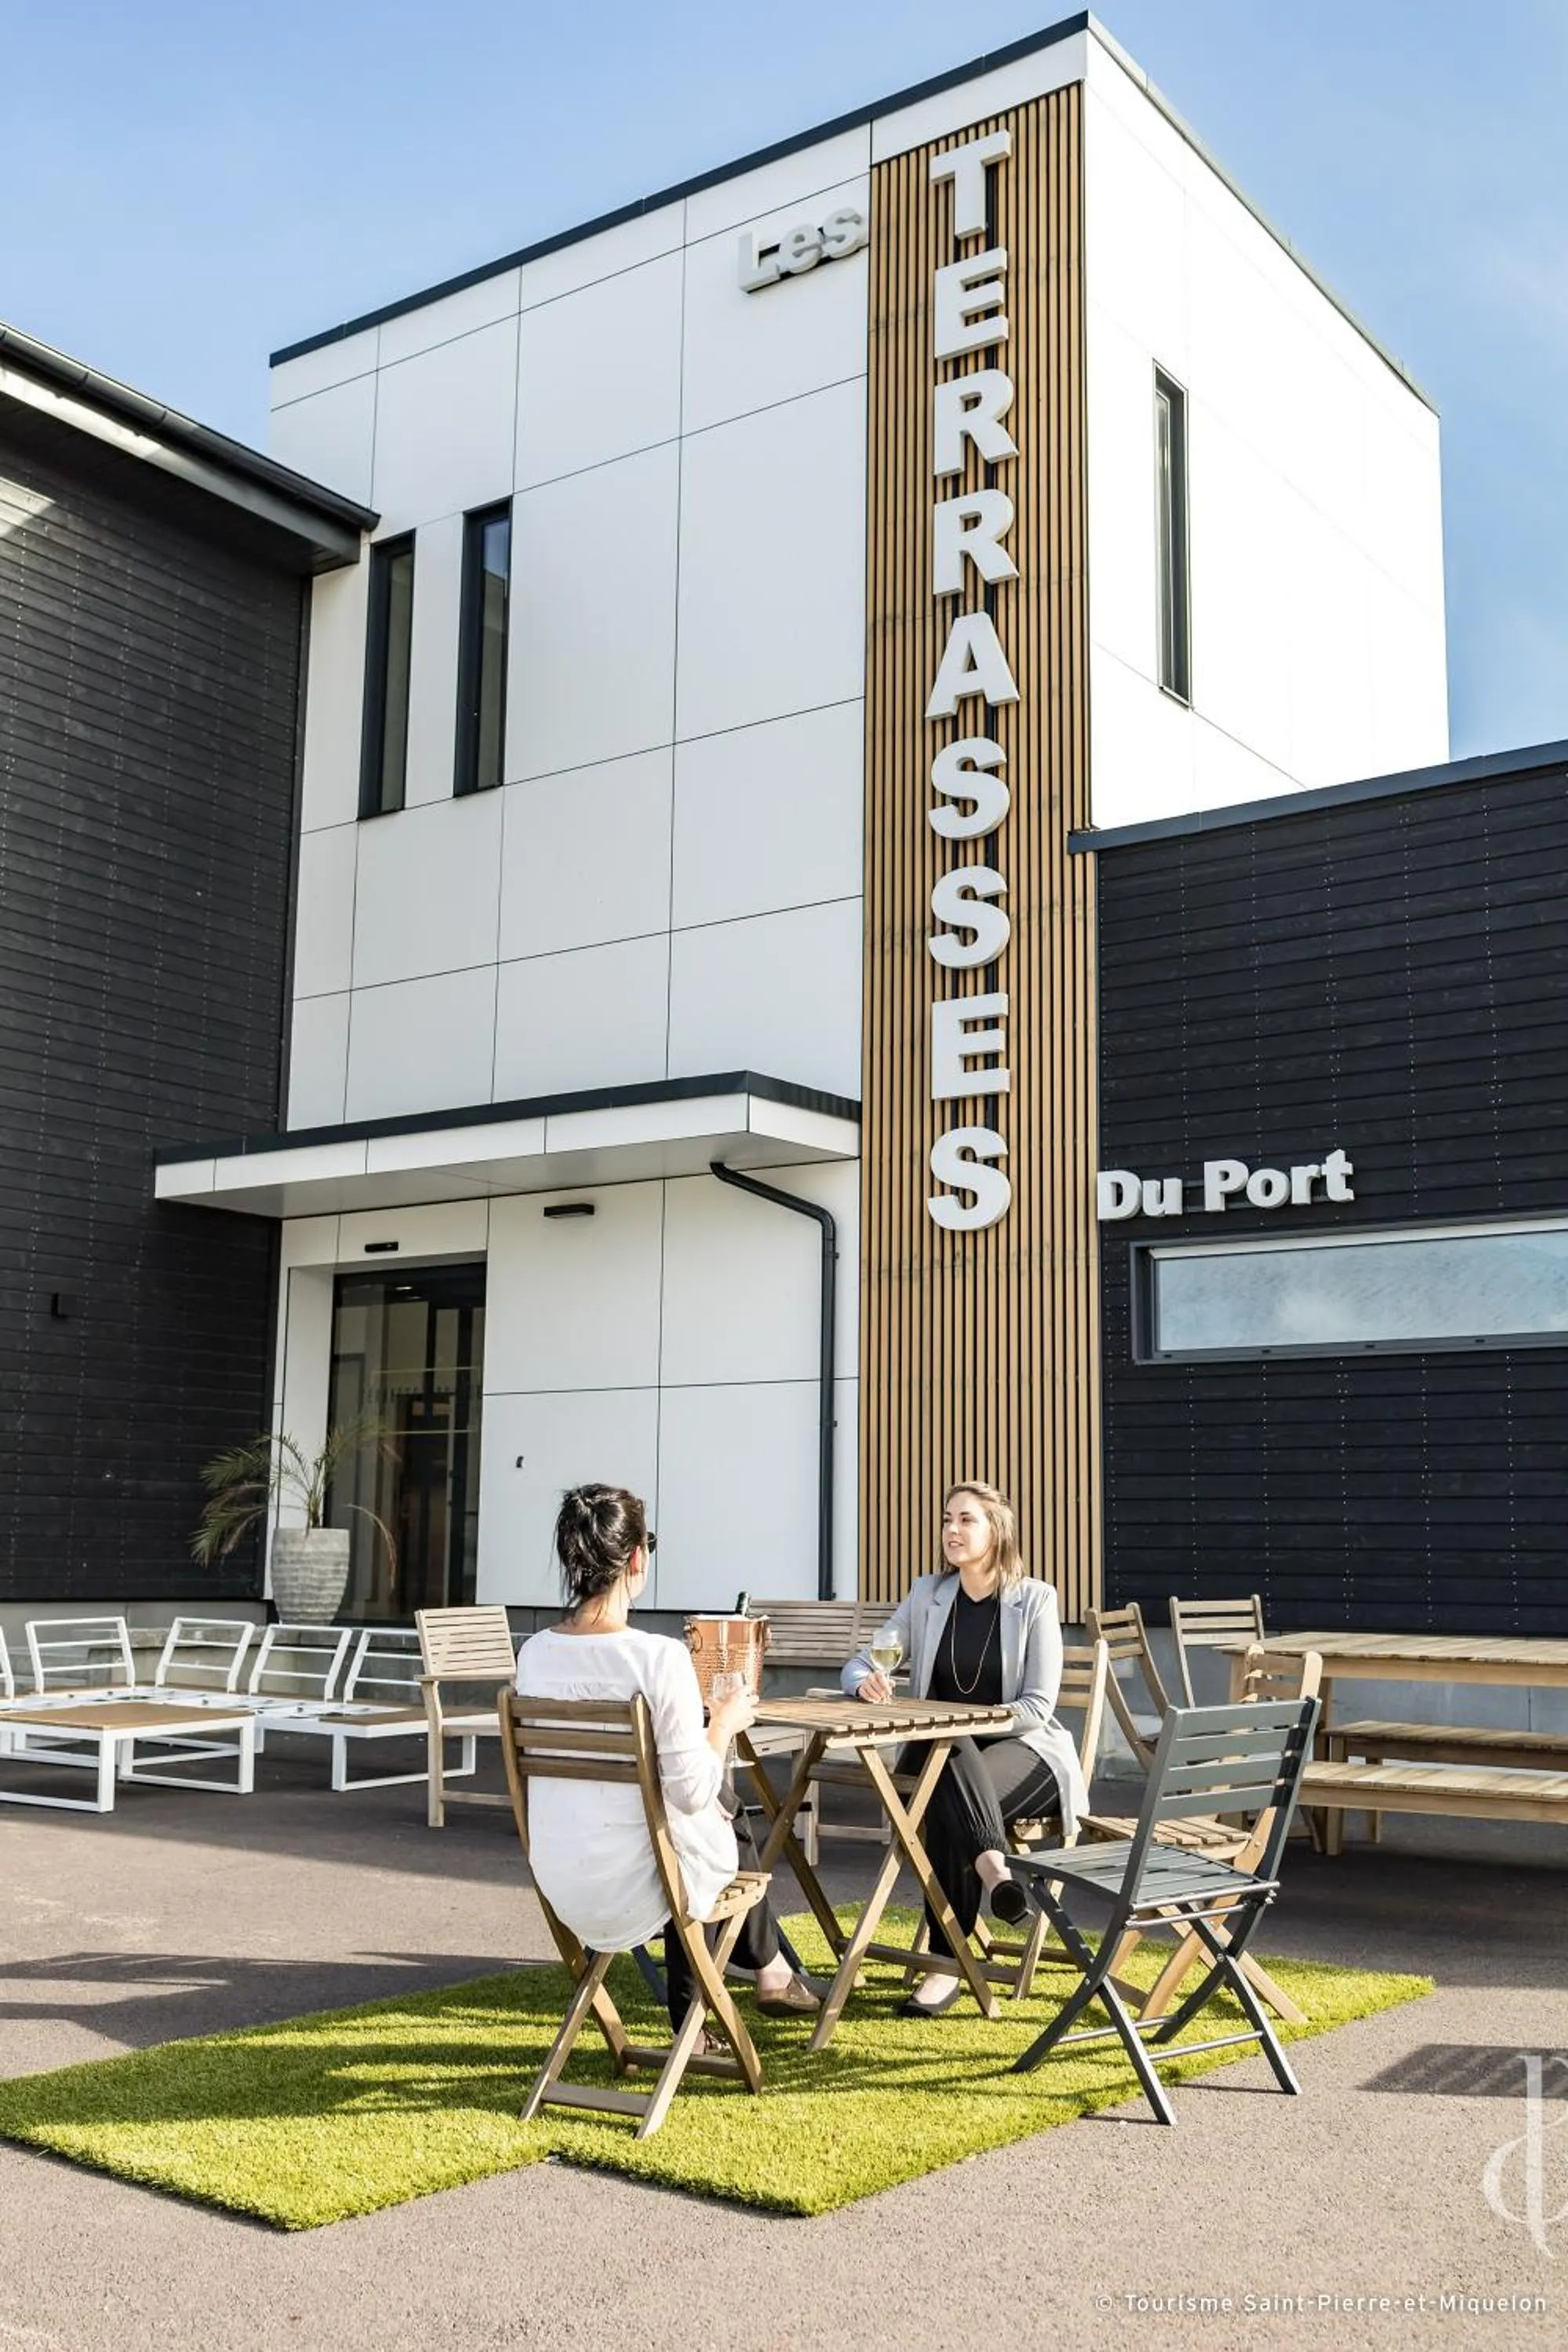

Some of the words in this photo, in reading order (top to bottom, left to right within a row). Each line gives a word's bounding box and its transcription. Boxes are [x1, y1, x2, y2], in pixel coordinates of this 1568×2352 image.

[738, 207, 869, 294] Les
[925, 129, 1019, 1232] TERRASSES
[1098, 1171, 1182, 1220] Du
[1204, 1149, 1355, 1211] Port
